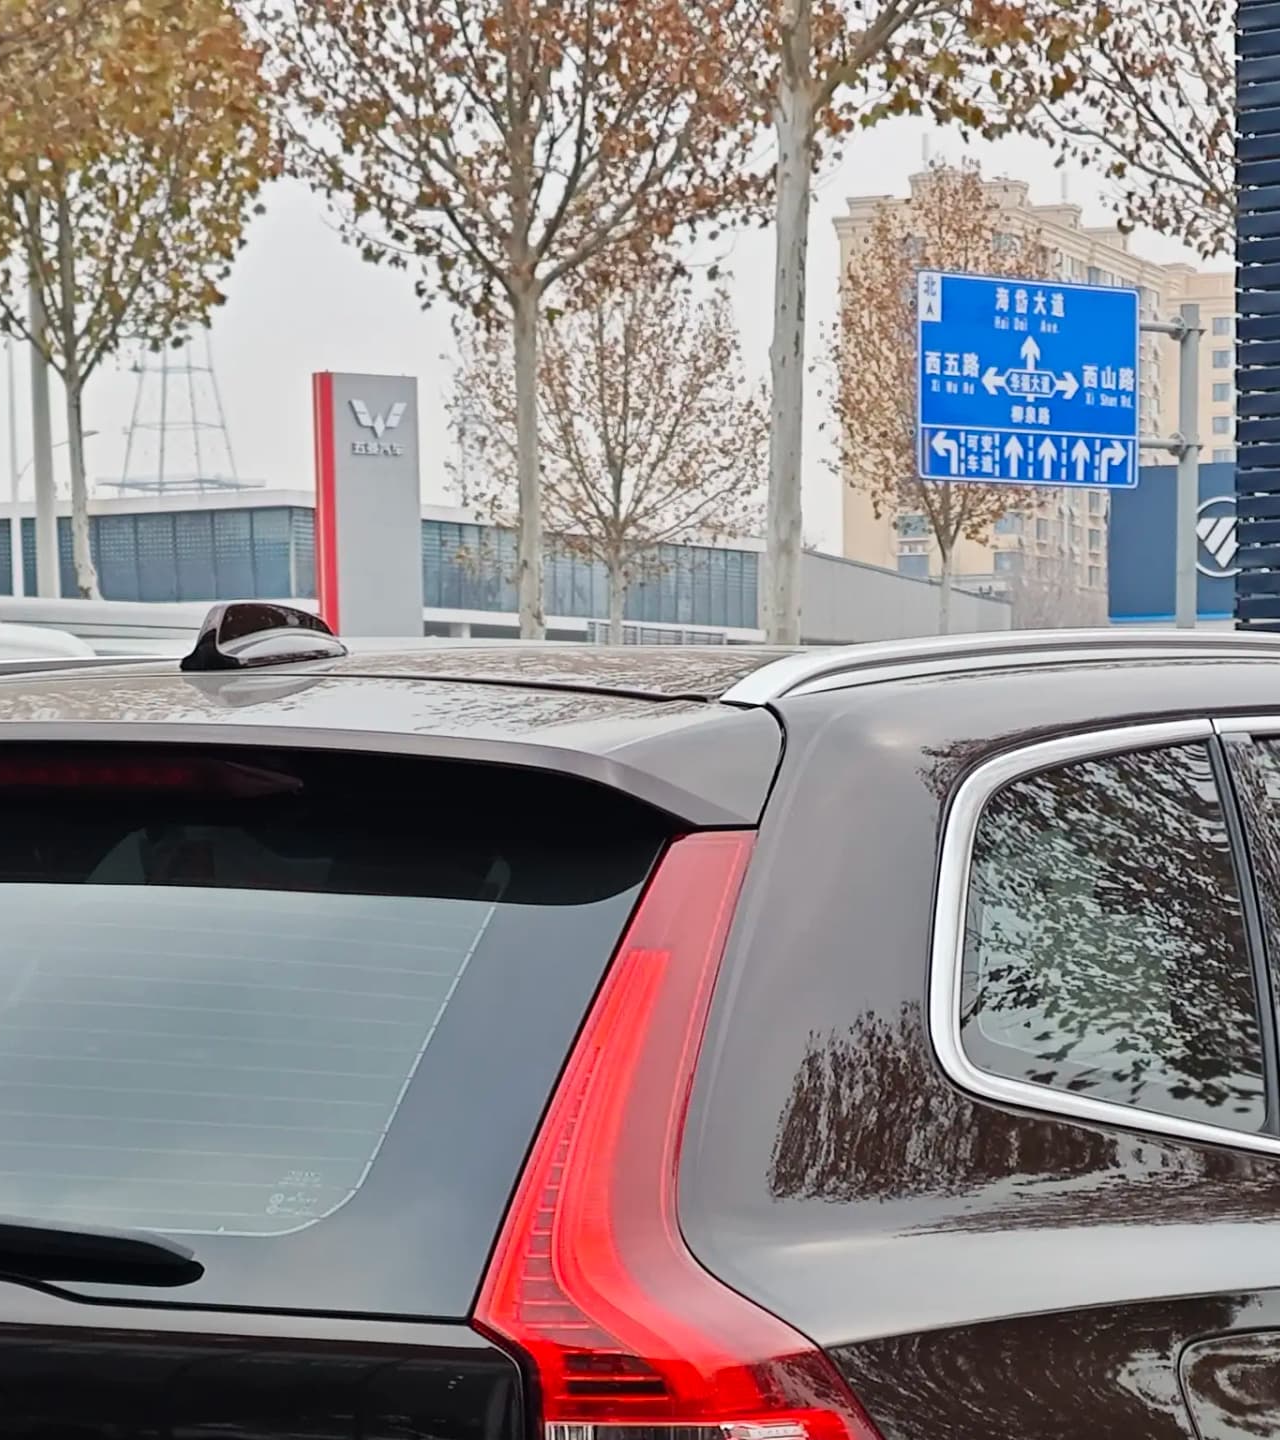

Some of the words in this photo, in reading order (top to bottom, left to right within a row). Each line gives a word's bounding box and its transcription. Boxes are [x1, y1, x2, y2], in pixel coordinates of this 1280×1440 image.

[923, 275, 937, 297] 北
[924, 351, 980, 378] 西五路
[1082, 364, 1135, 392] 西山路
